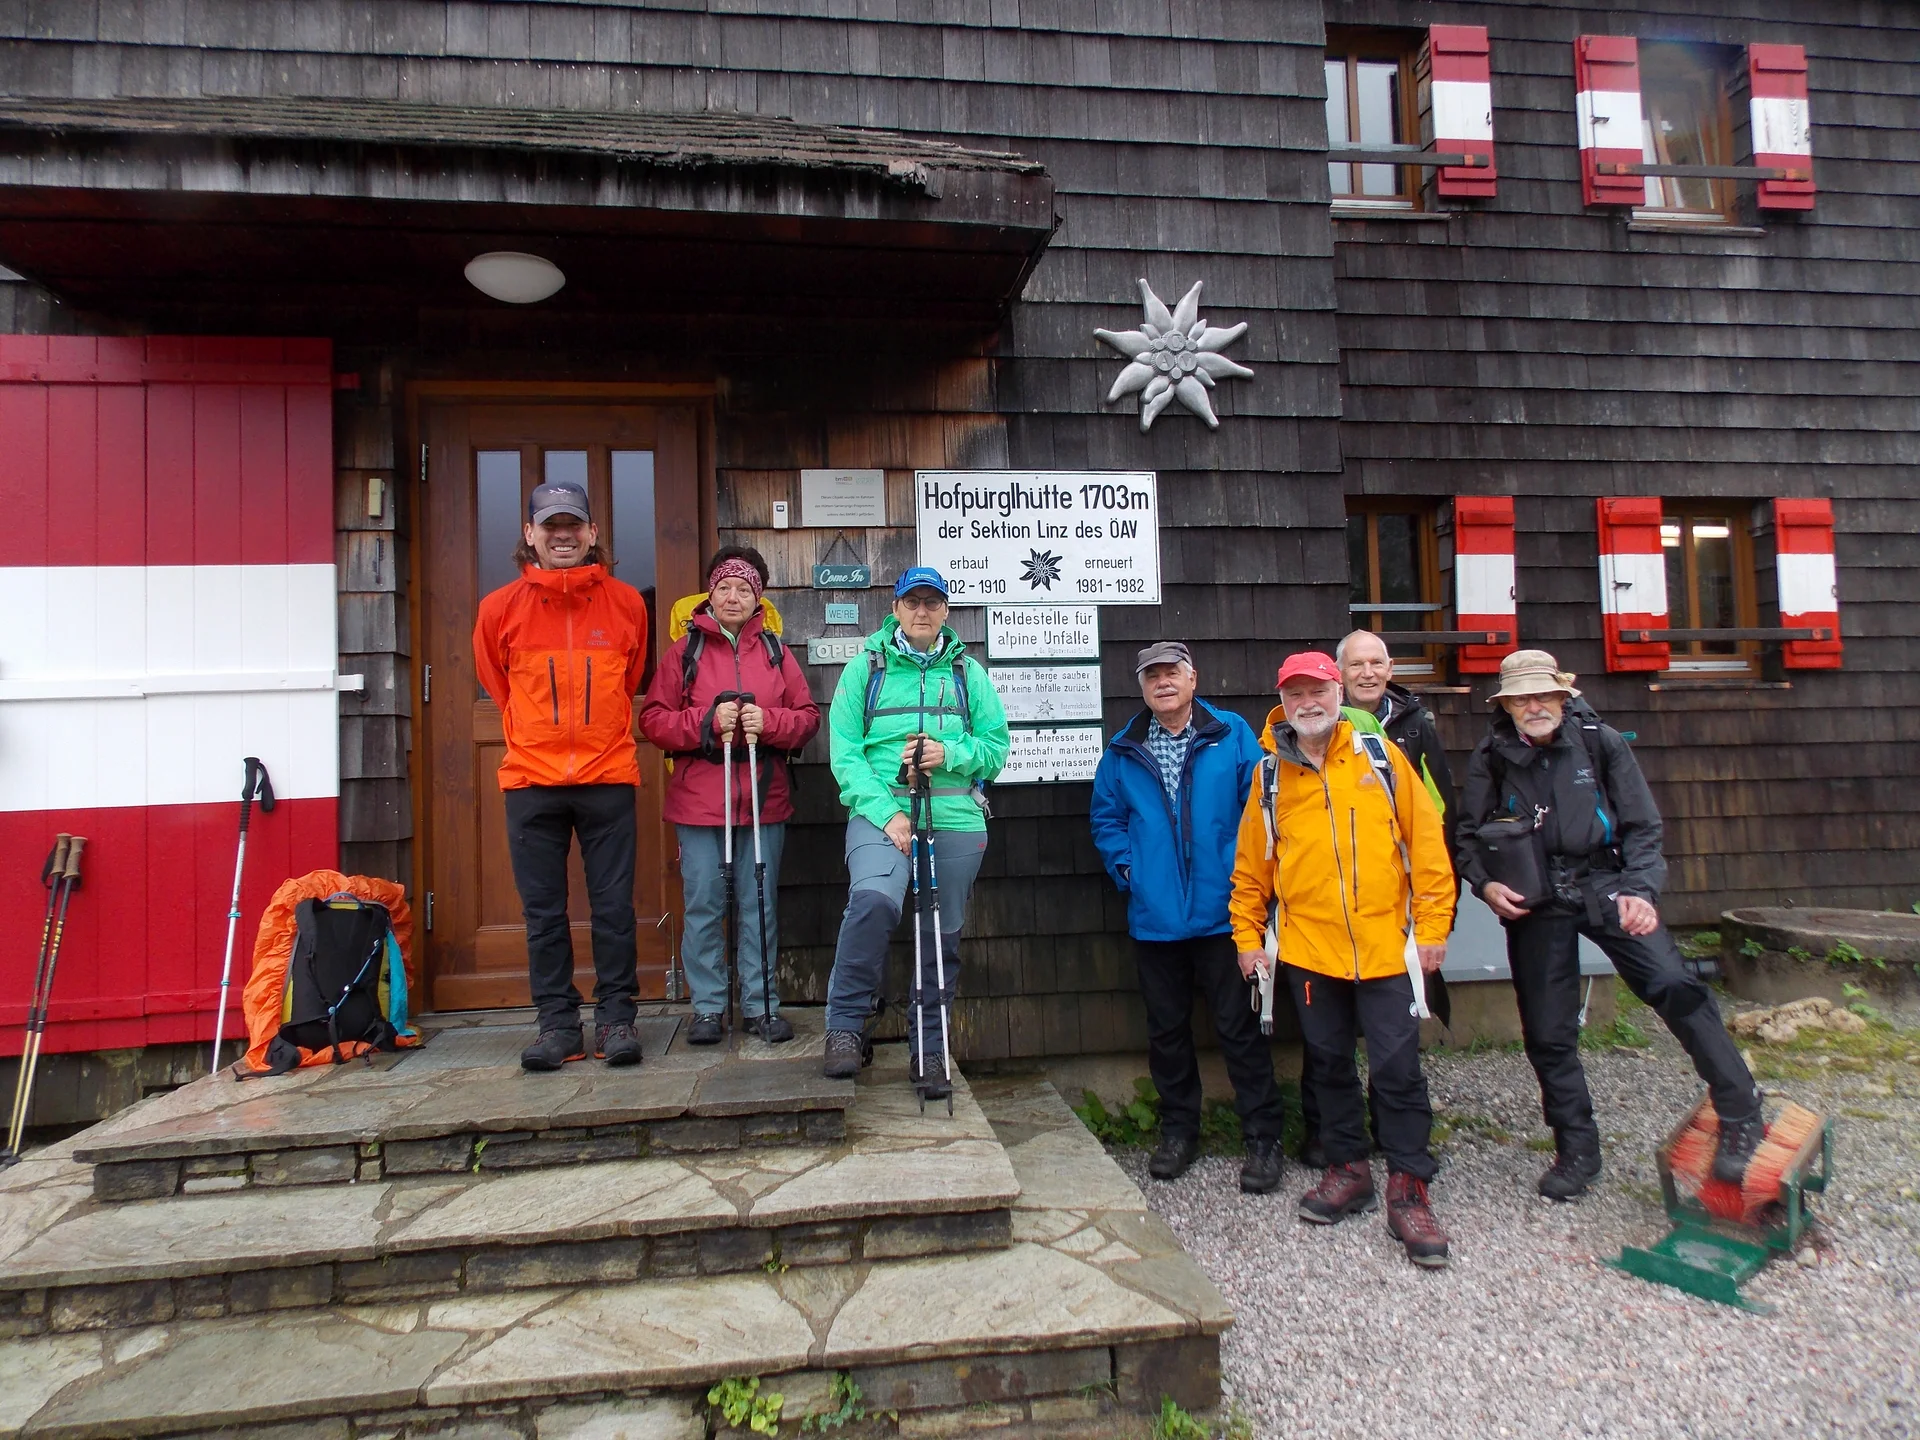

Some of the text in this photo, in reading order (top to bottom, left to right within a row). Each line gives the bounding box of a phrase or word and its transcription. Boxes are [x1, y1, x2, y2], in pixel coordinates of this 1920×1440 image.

[924, 481, 1149, 518] Hofpürglhütte 1703m
[938, 517, 1138, 539] der Sektion Linz des ÖAV
[950, 556, 989, 570] erbaut
[1085, 557, 1133, 570] erneuert
[819, 568, 865, 585] Come In
[829, 609, 855, 618] WE'RE
[992, 610, 1093, 626] Meldestelle für
[998, 630, 1089, 649] alpine Unfälle
[992, 671, 1014, 681] Haltet
[1019, 671, 1031, 680] die
[1035, 670, 1058, 682] Berge
[1062, 670, 1090, 680] sauber
[992, 684, 1009, 694] aßt
[1012, 684, 1032, 693] keine
[1035, 683, 1061, 693] Abfälle
[1064, 683, 1091, 692] zurück
[1023, 735, 1033, 743] im
[1036, 732, 1075, 743] Interesse
[1079, 733, 1093, 742] der
[1059, 745, 1100, 755] markierte
[1026, 759, 1047, 769] nicht
[1052, 757, 1097, 768] verlassen!
